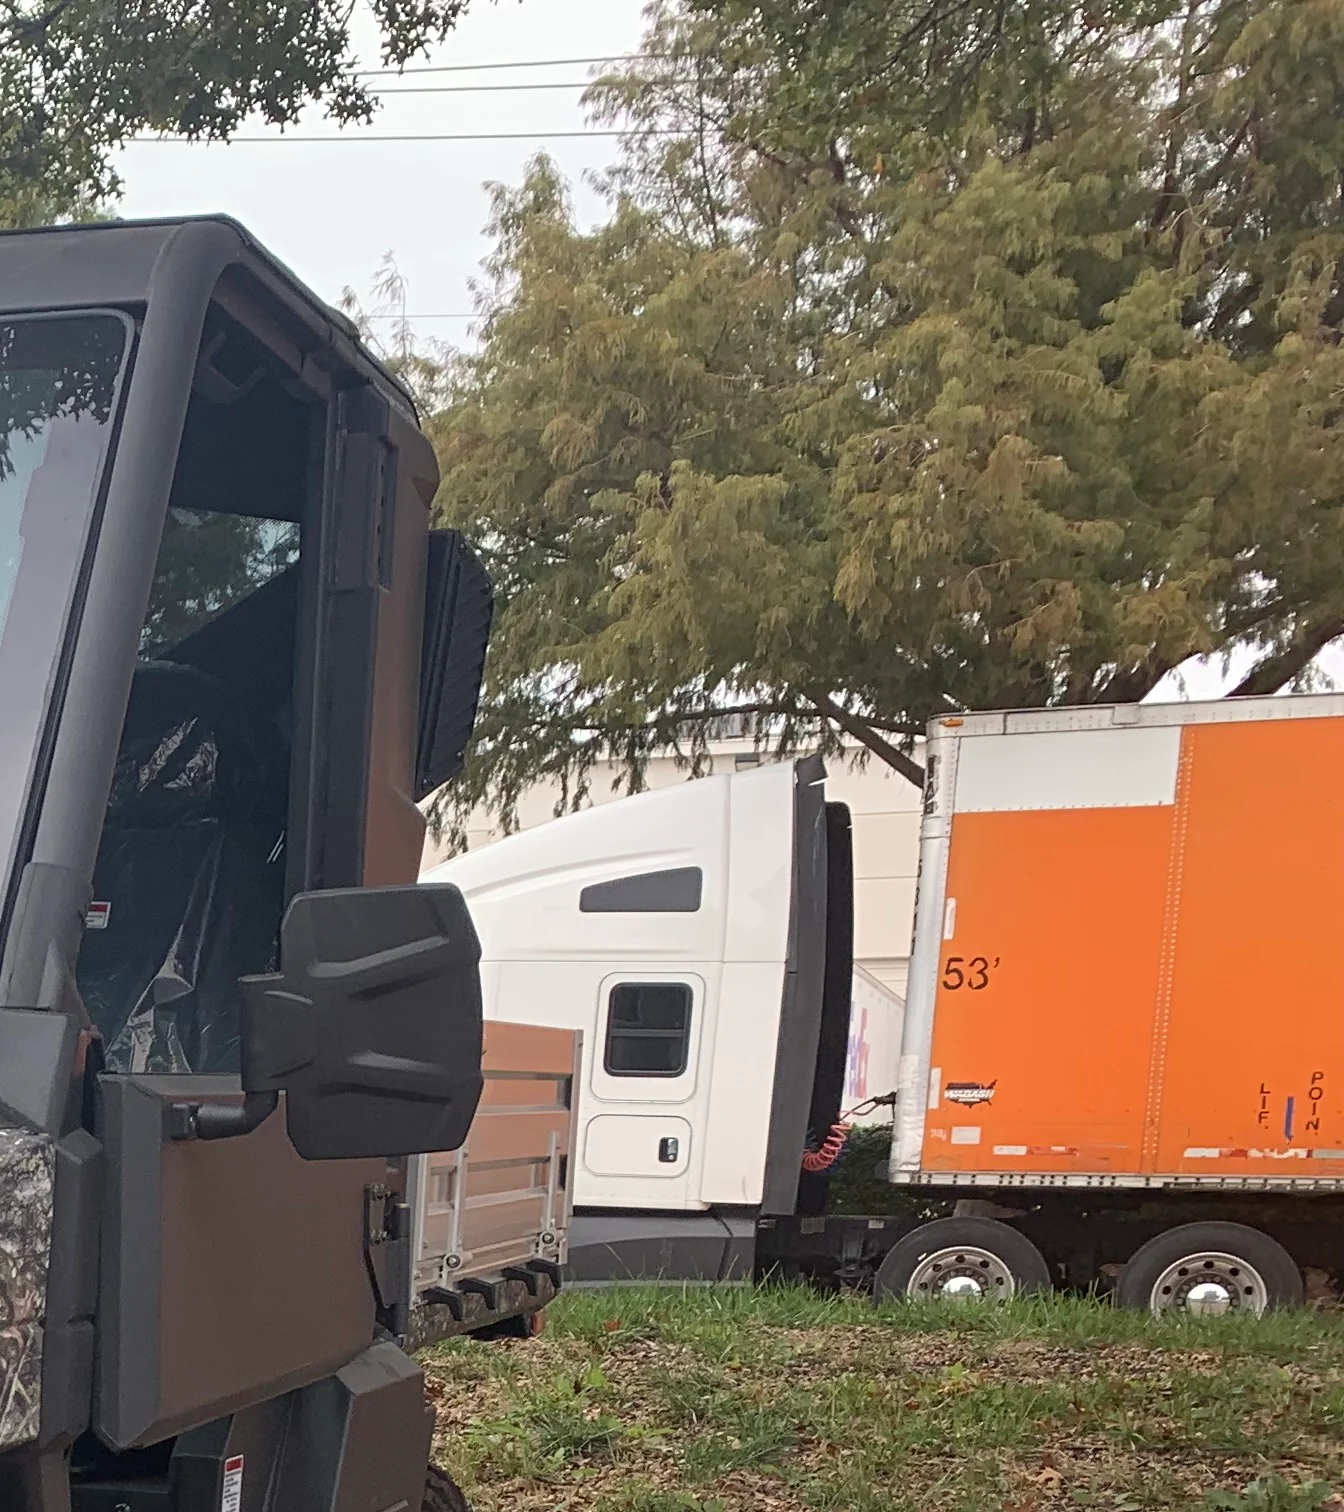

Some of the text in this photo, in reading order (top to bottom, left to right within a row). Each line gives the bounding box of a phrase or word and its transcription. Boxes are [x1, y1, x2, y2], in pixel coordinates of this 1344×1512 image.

[942, 956, 1000, 990] 53'
[1258, 1083, 1271, 1129] LIF
[1305, 1071, 1324, 1136] POIN
